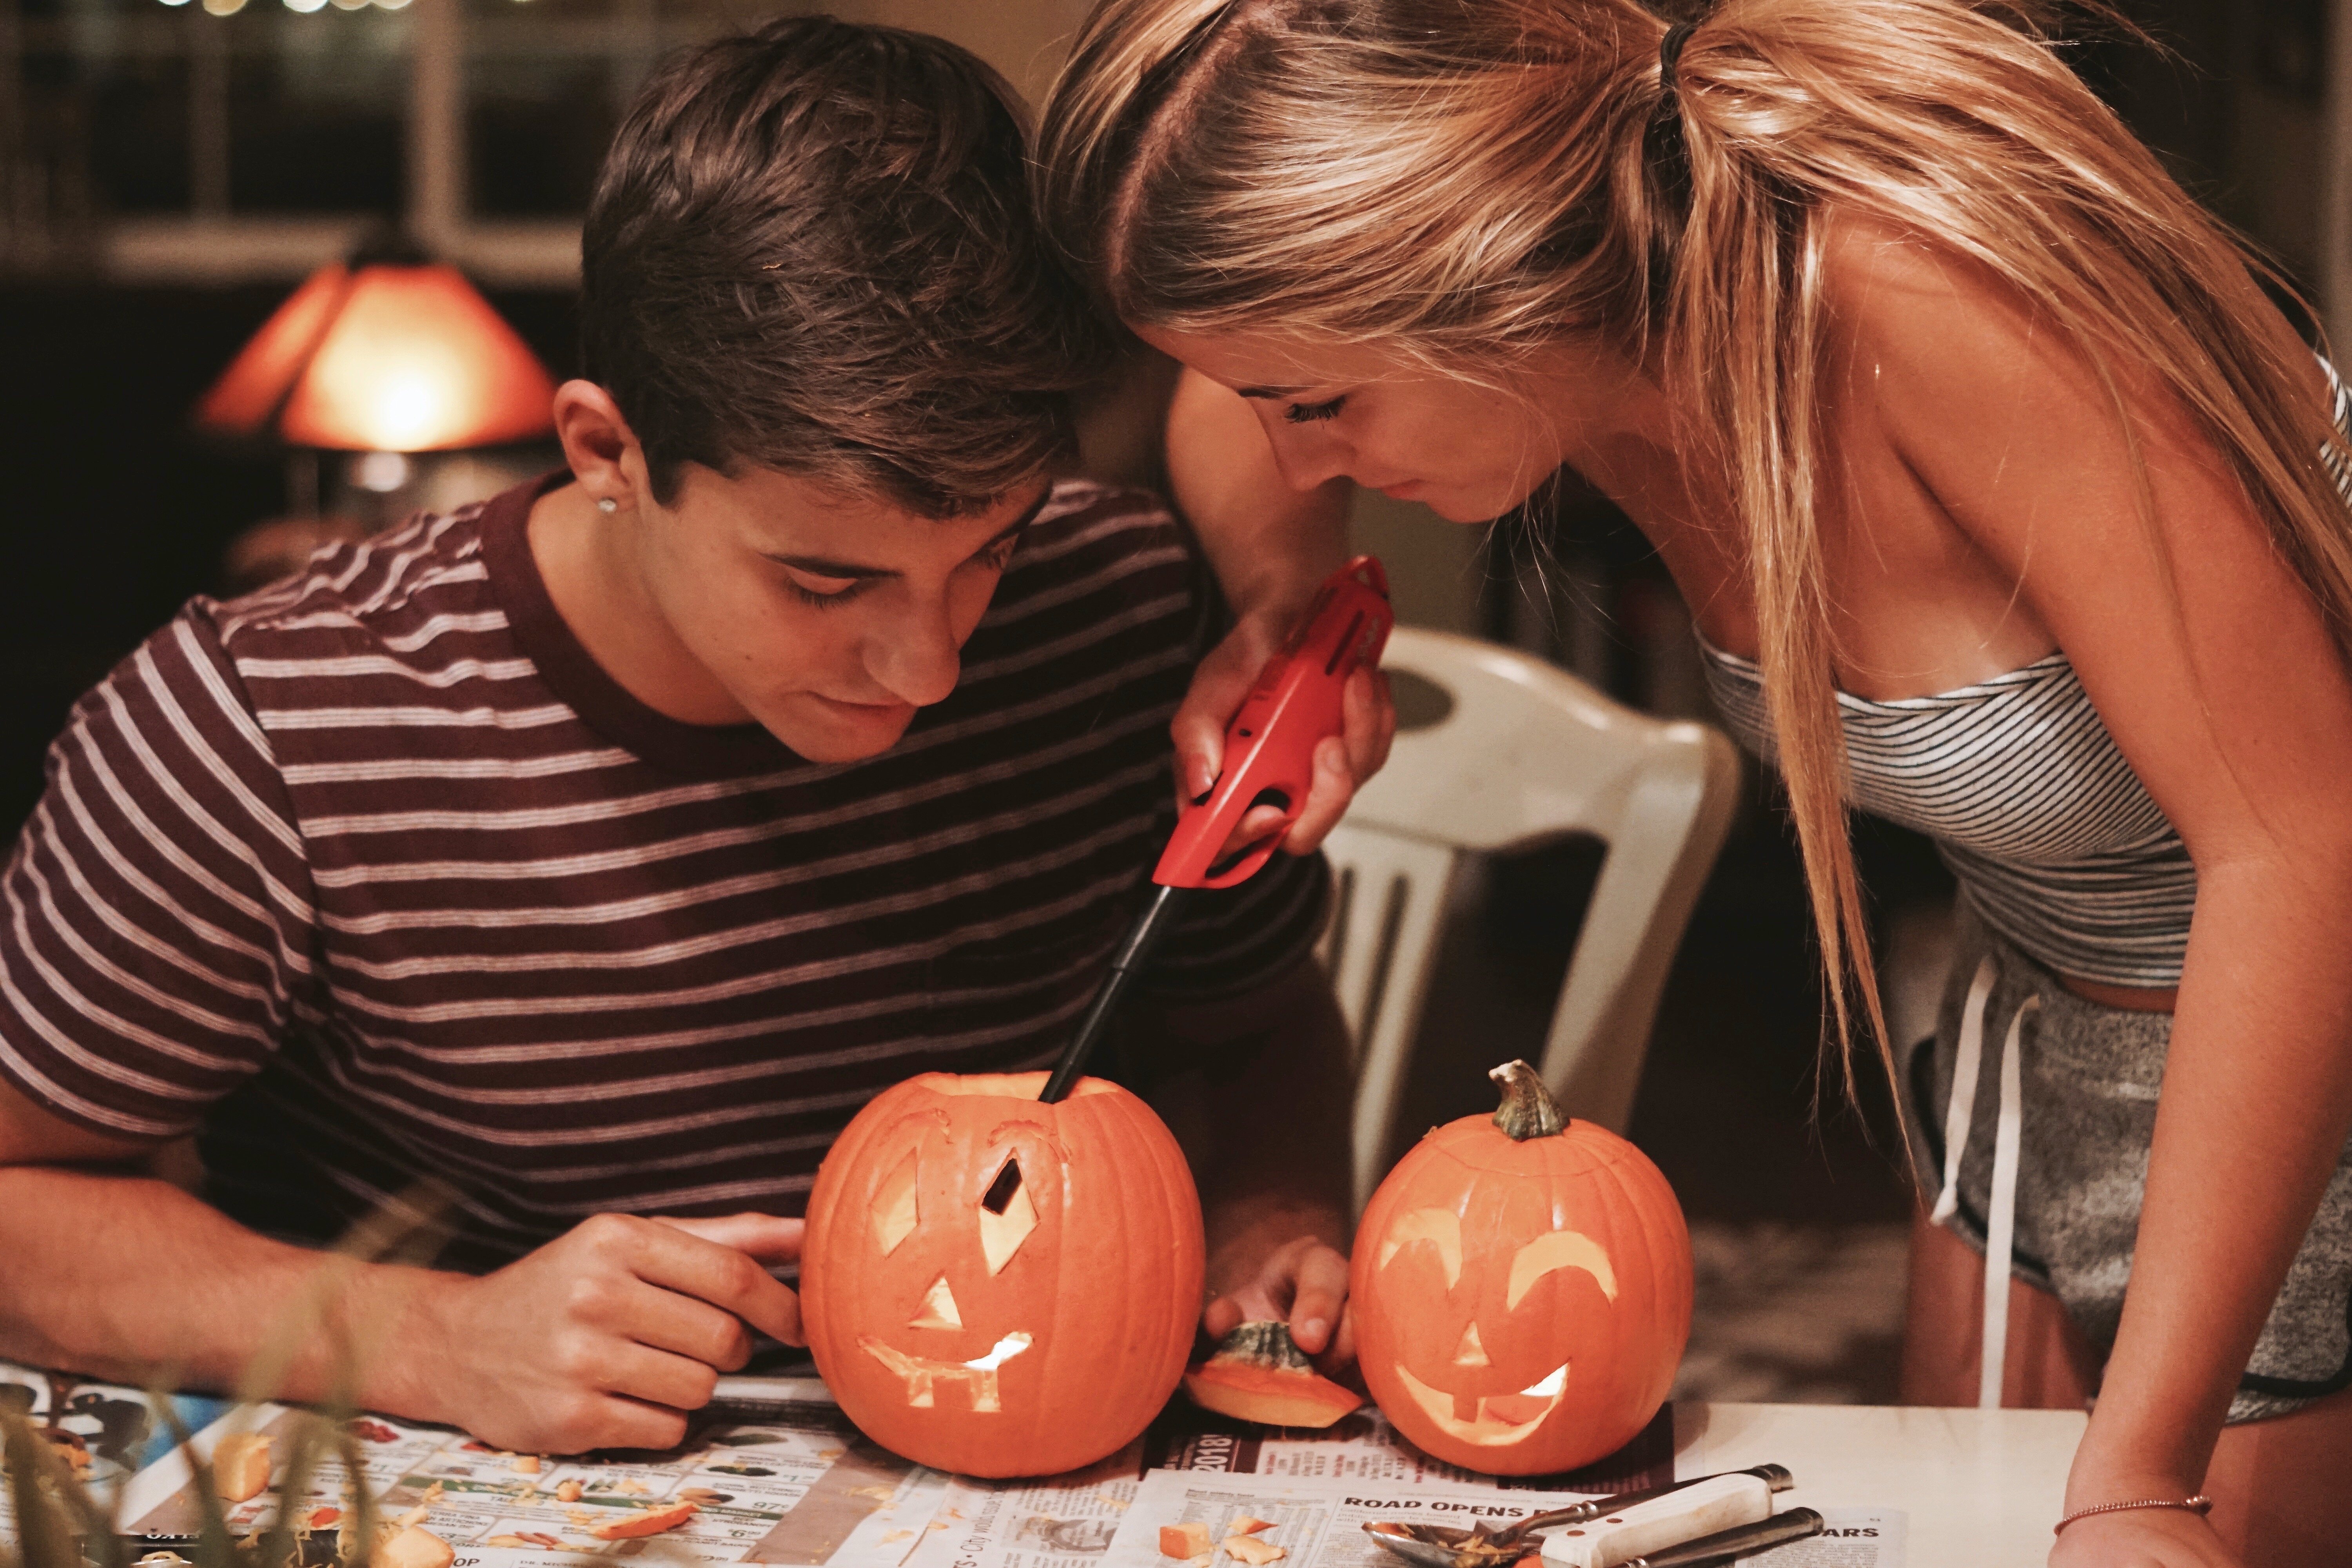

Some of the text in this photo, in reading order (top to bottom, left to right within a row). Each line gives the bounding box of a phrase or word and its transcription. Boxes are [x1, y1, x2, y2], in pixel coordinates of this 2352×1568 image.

[1344, 1497, 1422, 1508] ROAD
[1431, 1502, 1524, 1517] OPENS
[960, 1535, 992, 1551] City
